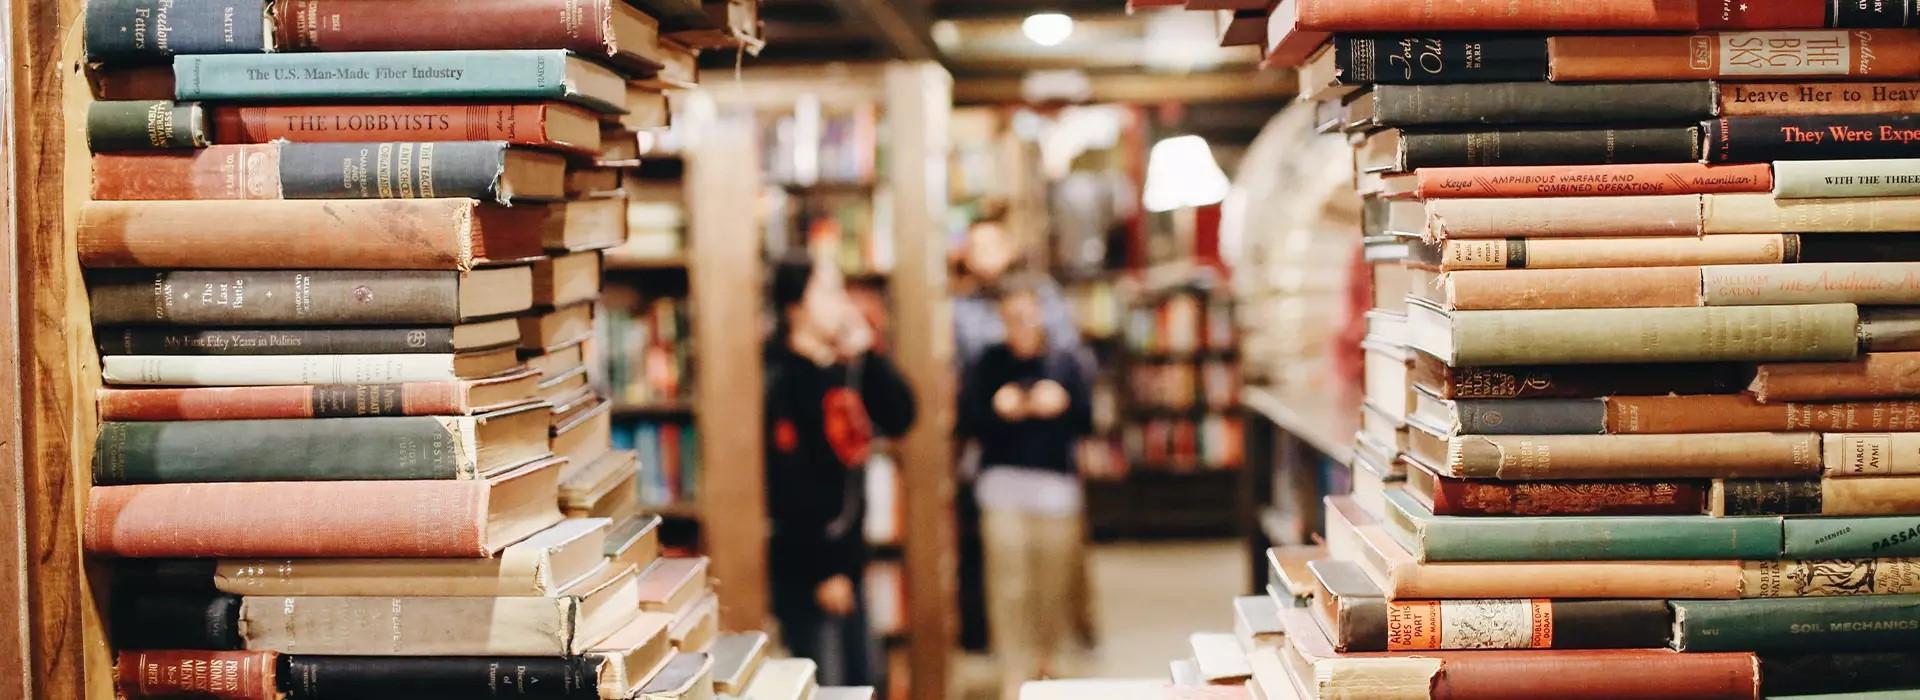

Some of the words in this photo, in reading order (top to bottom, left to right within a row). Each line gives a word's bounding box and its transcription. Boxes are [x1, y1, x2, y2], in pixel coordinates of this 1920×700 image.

[135, 8, 150, 49] Fetters
[223, 7, 234, 43] SMITH
[1729, 37, 1768, 69] SKY
[1768, 38, 1802, 67] BIG
[1806, 36, 1846, 67] THE
[1855, 31, 1873, 75] Guthrie
[247, 69, 269, 80] The
[274, 68, 300, 80] U.S.
[304, 67, 370, 80] Man-Made
[375, 67, 408, 80] Fiber
[412, 66, 464, 81] Industry
[1735, 87, 1789, 103] Leave
[1799, 87, 1833, 103] Her
[1843, 90, 1862, 103] to
[149, 104, 159, 146] COLUMBIA
[156, 100, 169, 146] NIVERSITY
[165, 110, 174, 139] PRESS
[284, 115, 328, 131] THE
[336, 114, 450, 131] LOBBYISTS
[1781, 127, 1824, 144] They
[1830, 127, 1873, 143] Were
[343, 158, 352, 189] KINDRED
[1440, 178, 1472, 193] Keyes
[1491, 175, 1556, 186] AMPHIBIOUS
[1560, 174, 1608, 184] WARFARE
[1611, 173, 1635, 183] AND
[1825, 176, 1853, 185] WITH
[1858, 176, 1880, 185] THE
[1537, 184, 1593, 193] COMBINED
[1597, 182, 1664, 193] OPERATIONS
[295, 273, 303, 288] AND
[1719, 287, 1762, 297] GAUNT
[165, 283, 174, 308] RYAN
[202, 283, 214, 305] The
[217, 283, 229, 306] Last
[232, 279, 244, 310] Battle
[165, 335, 181, 348] My
[206, 335, 230, 348] Fifty
[231, 335, 256, 347] Years
[258, 335, 267, 346] in
[269, 334, 301, 347] Politics
[1854, 439, 1864, 473] MARCEL
[1759, 558, 1770, 597] ROBER
[1771, 562, 1781, 597] NATHA
[1390, 606, 1402, 644] ARCHY
[1403, 605, 1411, 621] HIS
[1414, 613, 1423, 637] PART
[1534, 603, 1542, 647] DOUBLEDAY
[1543, 612, 1551, 638] DORAN
[1702, 628, 1719, 636] WU
[1790, 623, 1824, 634] SOIL
[1830, 619, 1919, 632] MECHANICS
[210, 659, 223, 693] SIONAL
